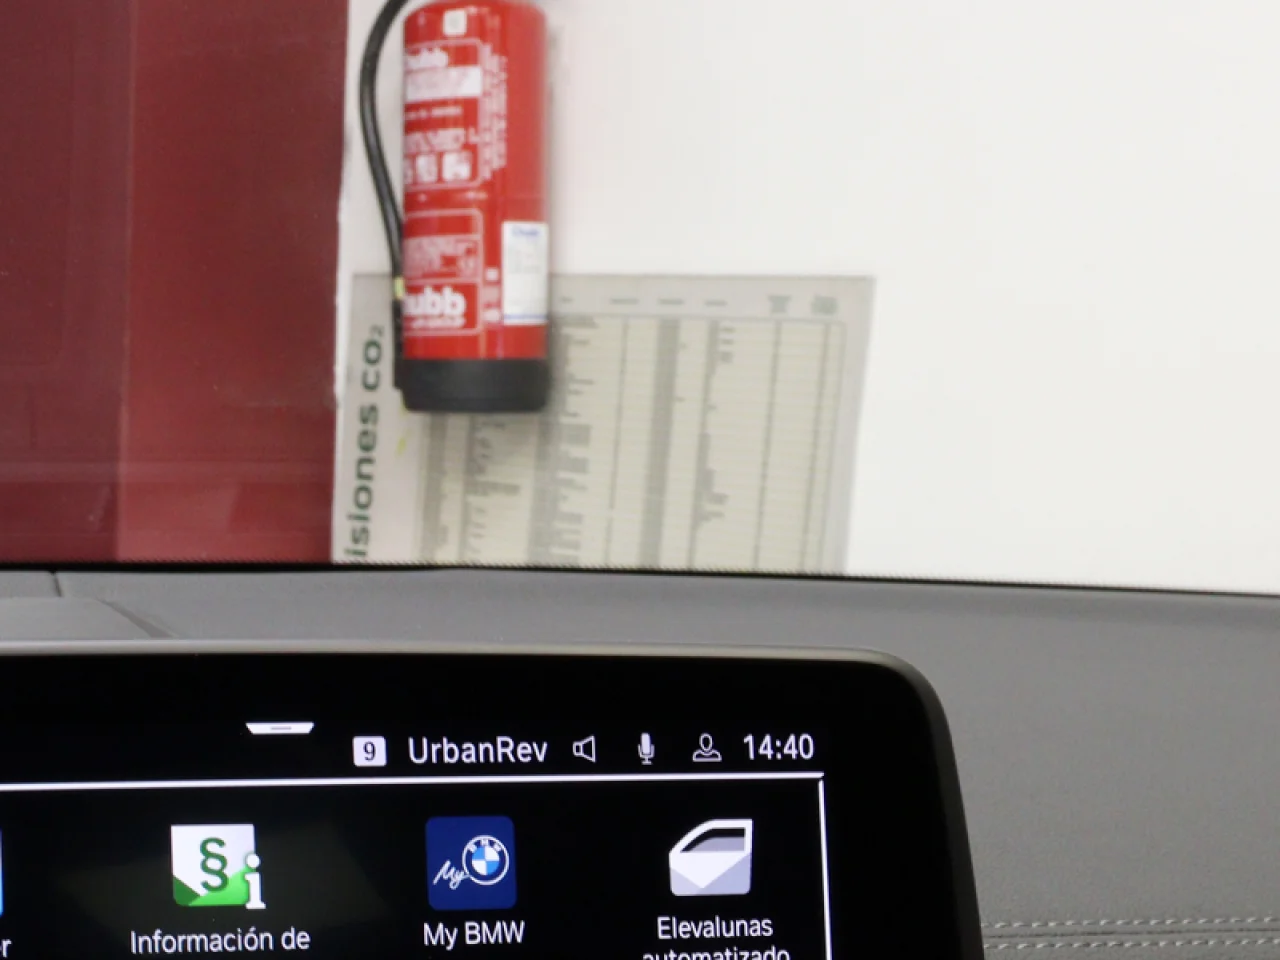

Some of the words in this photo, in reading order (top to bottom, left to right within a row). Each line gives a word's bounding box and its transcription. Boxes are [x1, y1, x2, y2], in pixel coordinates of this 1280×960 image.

[363, 741, 376, 762] 9
[409, 735, 548, 764] UrbanRev
[744, 734, 815, 761] 14:40
[130, 926, 275, 955] Información
[280, 926, 311, 951] de
[423, 922, 458, 951] My
[465, 920, 526, 945] BMW
[657, 916, 774, 940] Elevalunas
